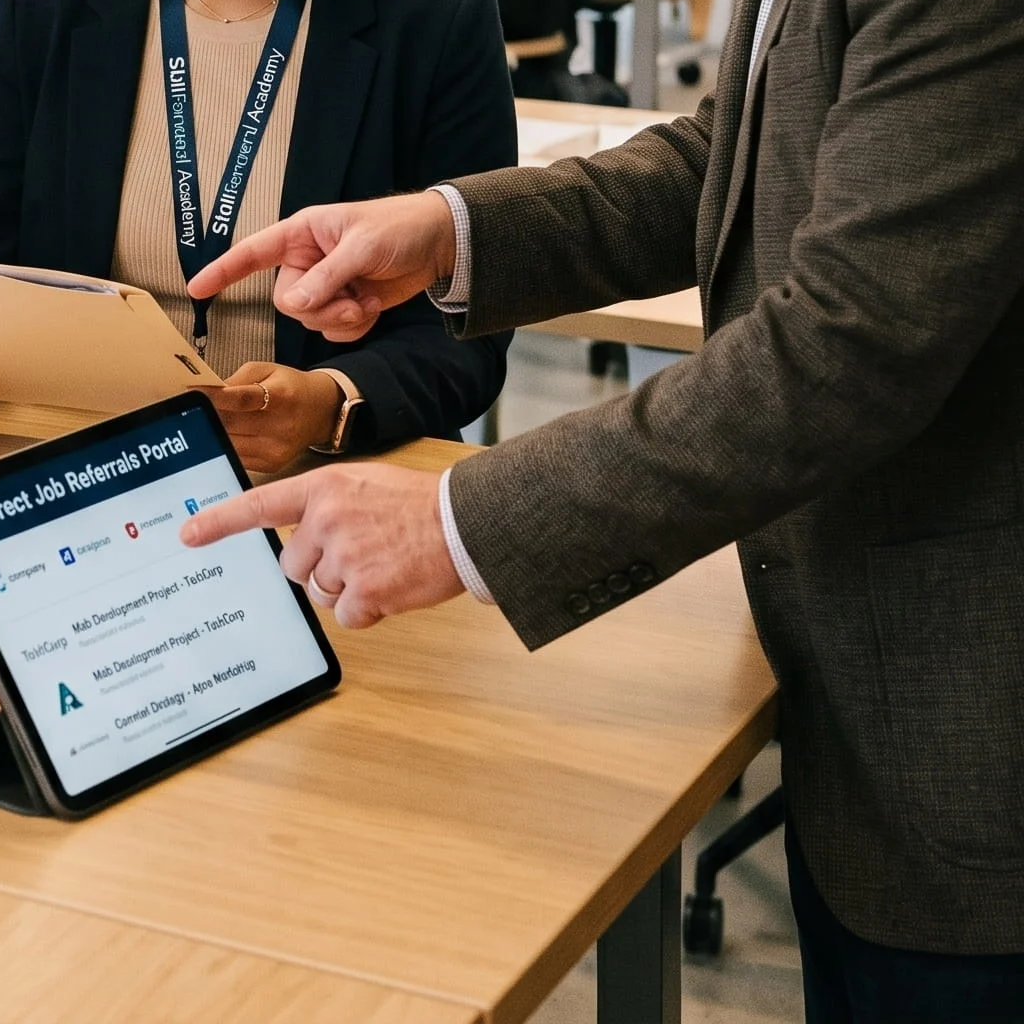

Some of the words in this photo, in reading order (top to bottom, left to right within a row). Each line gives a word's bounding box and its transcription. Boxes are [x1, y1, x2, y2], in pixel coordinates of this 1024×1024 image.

[247, 47, 286, 124] Academy
[35, 477, 66, 505] Job
[64, 451, 141, 493] Referrals
[138, 429, 189, 465] Portal
[147, 582, 180, 603] Project
[168, 627, 201, 649] Project
